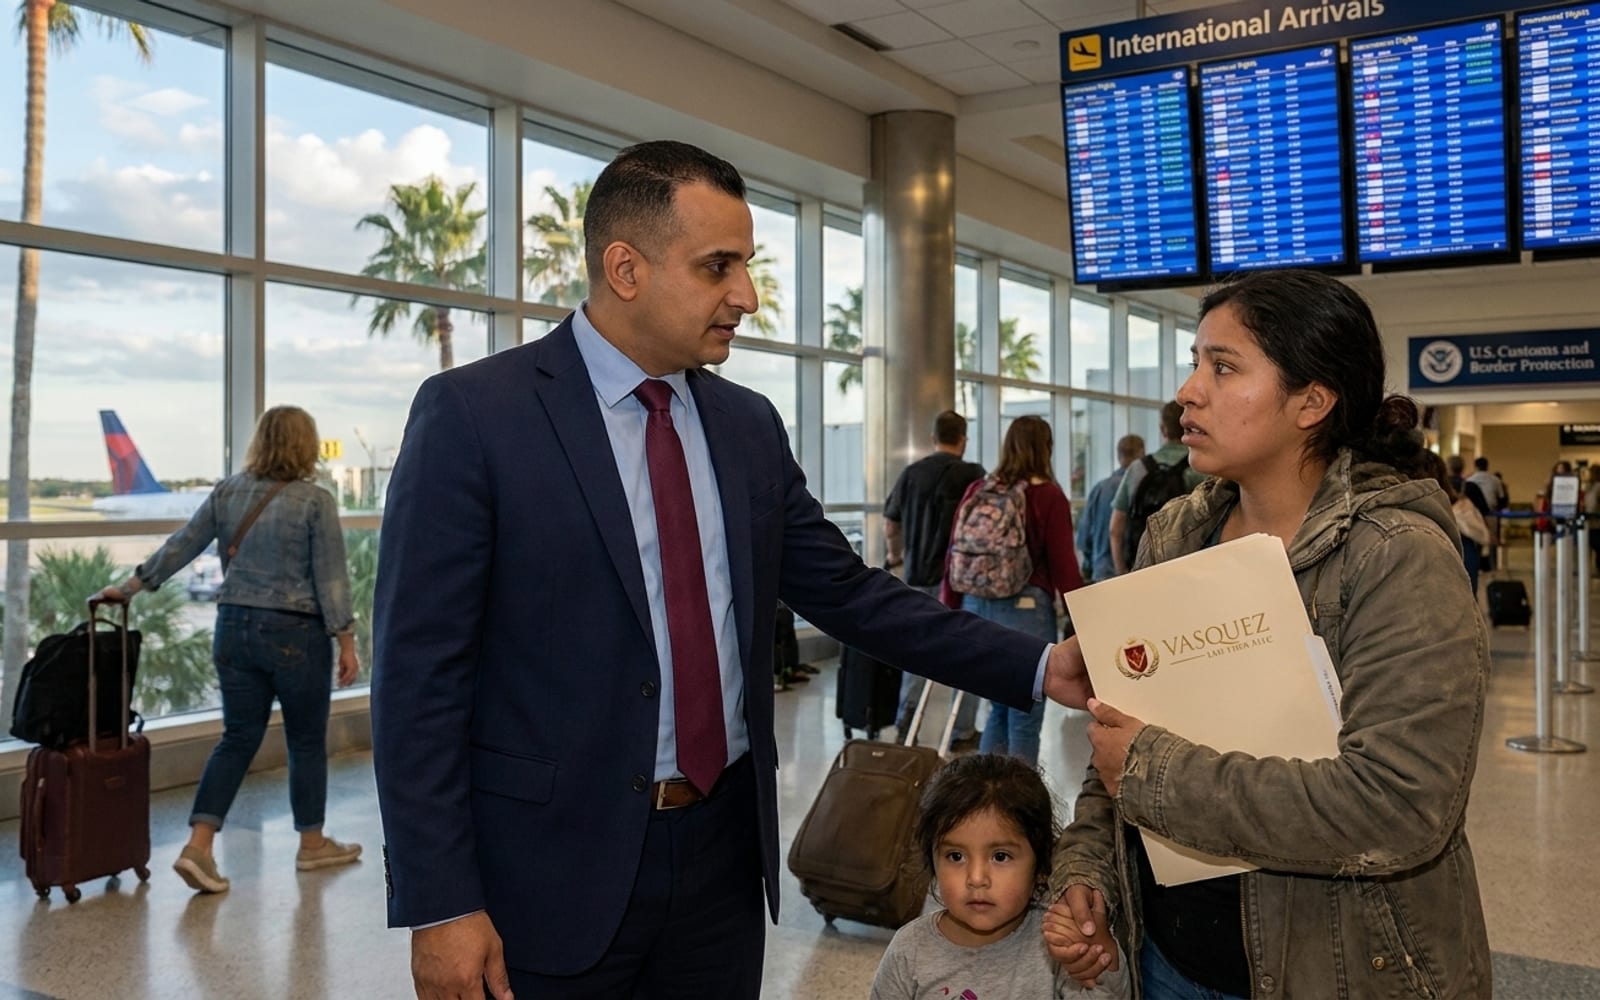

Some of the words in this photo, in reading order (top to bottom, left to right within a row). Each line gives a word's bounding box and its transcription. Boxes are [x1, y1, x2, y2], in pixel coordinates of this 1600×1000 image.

[1108, 9, 1270, 59] International
[1278, 0, 1385, 32] Arrivals
[1469, 345, 1497, 360] U.S.
[1497, 345, 1559, 358] Customs
[1562, 340, 1589, 355] and
[1520, 357, 1595, 372] Protection
[1161, 612, 1270, 656] VASQUEZ
